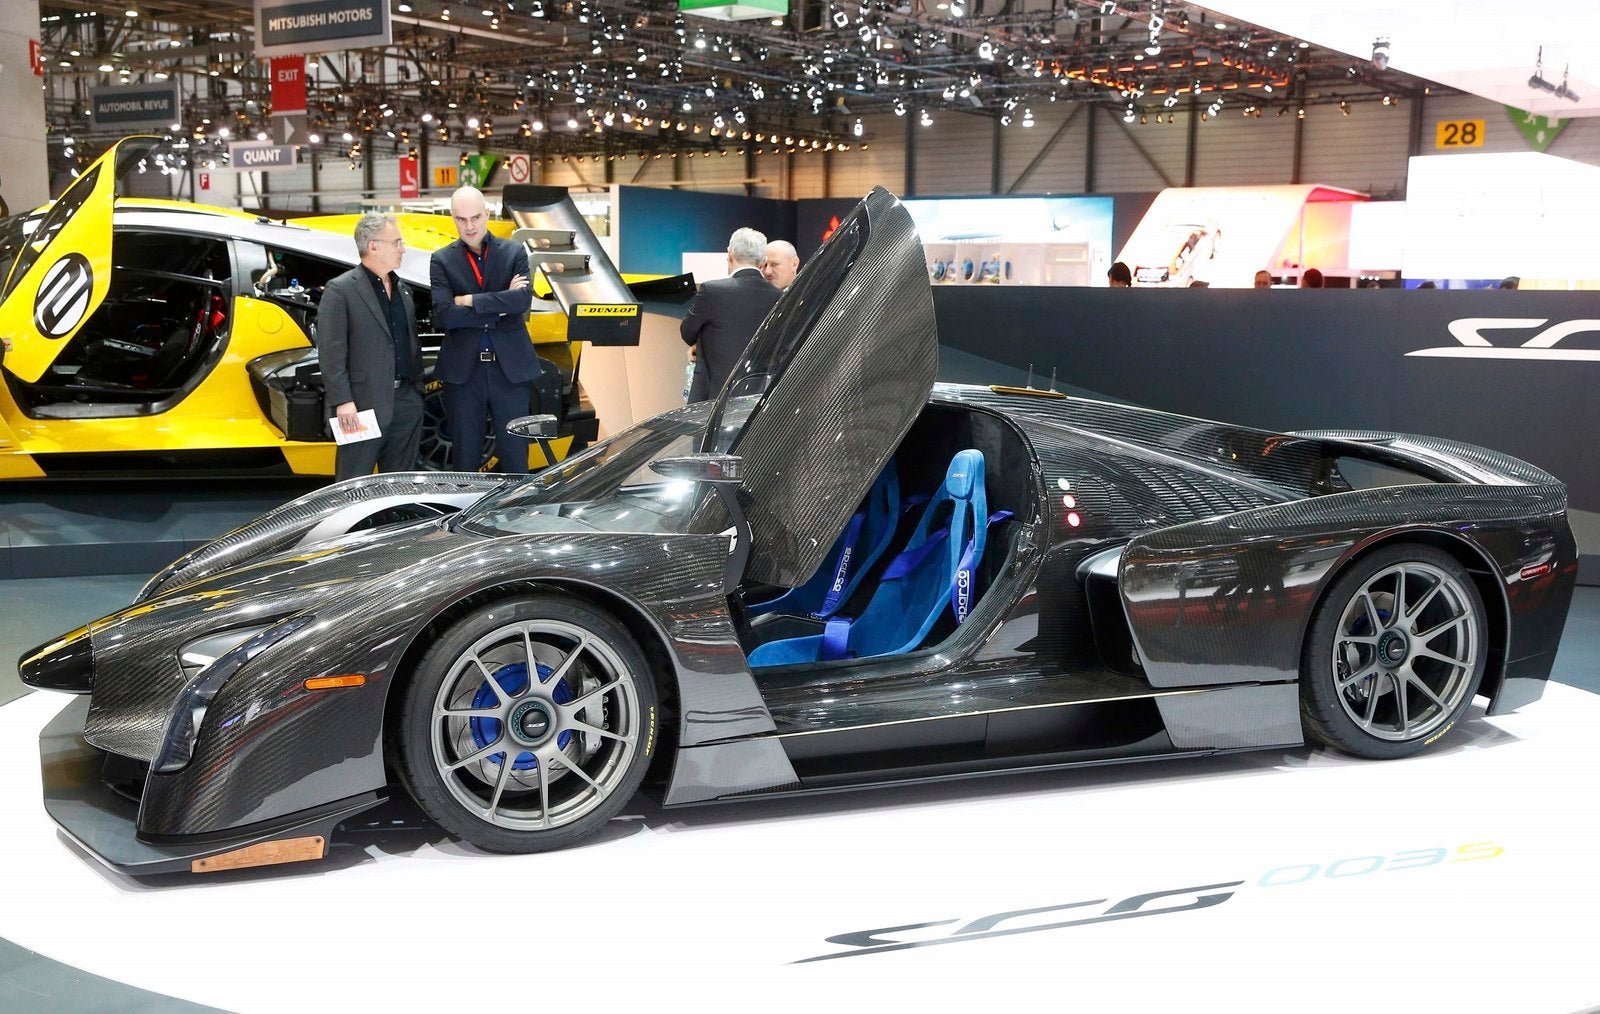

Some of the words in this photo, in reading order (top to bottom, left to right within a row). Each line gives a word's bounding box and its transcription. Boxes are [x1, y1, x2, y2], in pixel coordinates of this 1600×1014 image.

[268, 14, 326, 32] MITSUBISHI
[328, 8, 373, 25] MOTORS
[278, 69, 298, 82] EXIT
[99, 100, 144, 113] AUTOMOBIL
[144, 98, 169, 111] REVUE
[1444, 122, 1476, 145] 28
[243, 149, 282, 164] QUANT
[201, 174, 208, 187] F
[441, 168, 450, 184] 11
